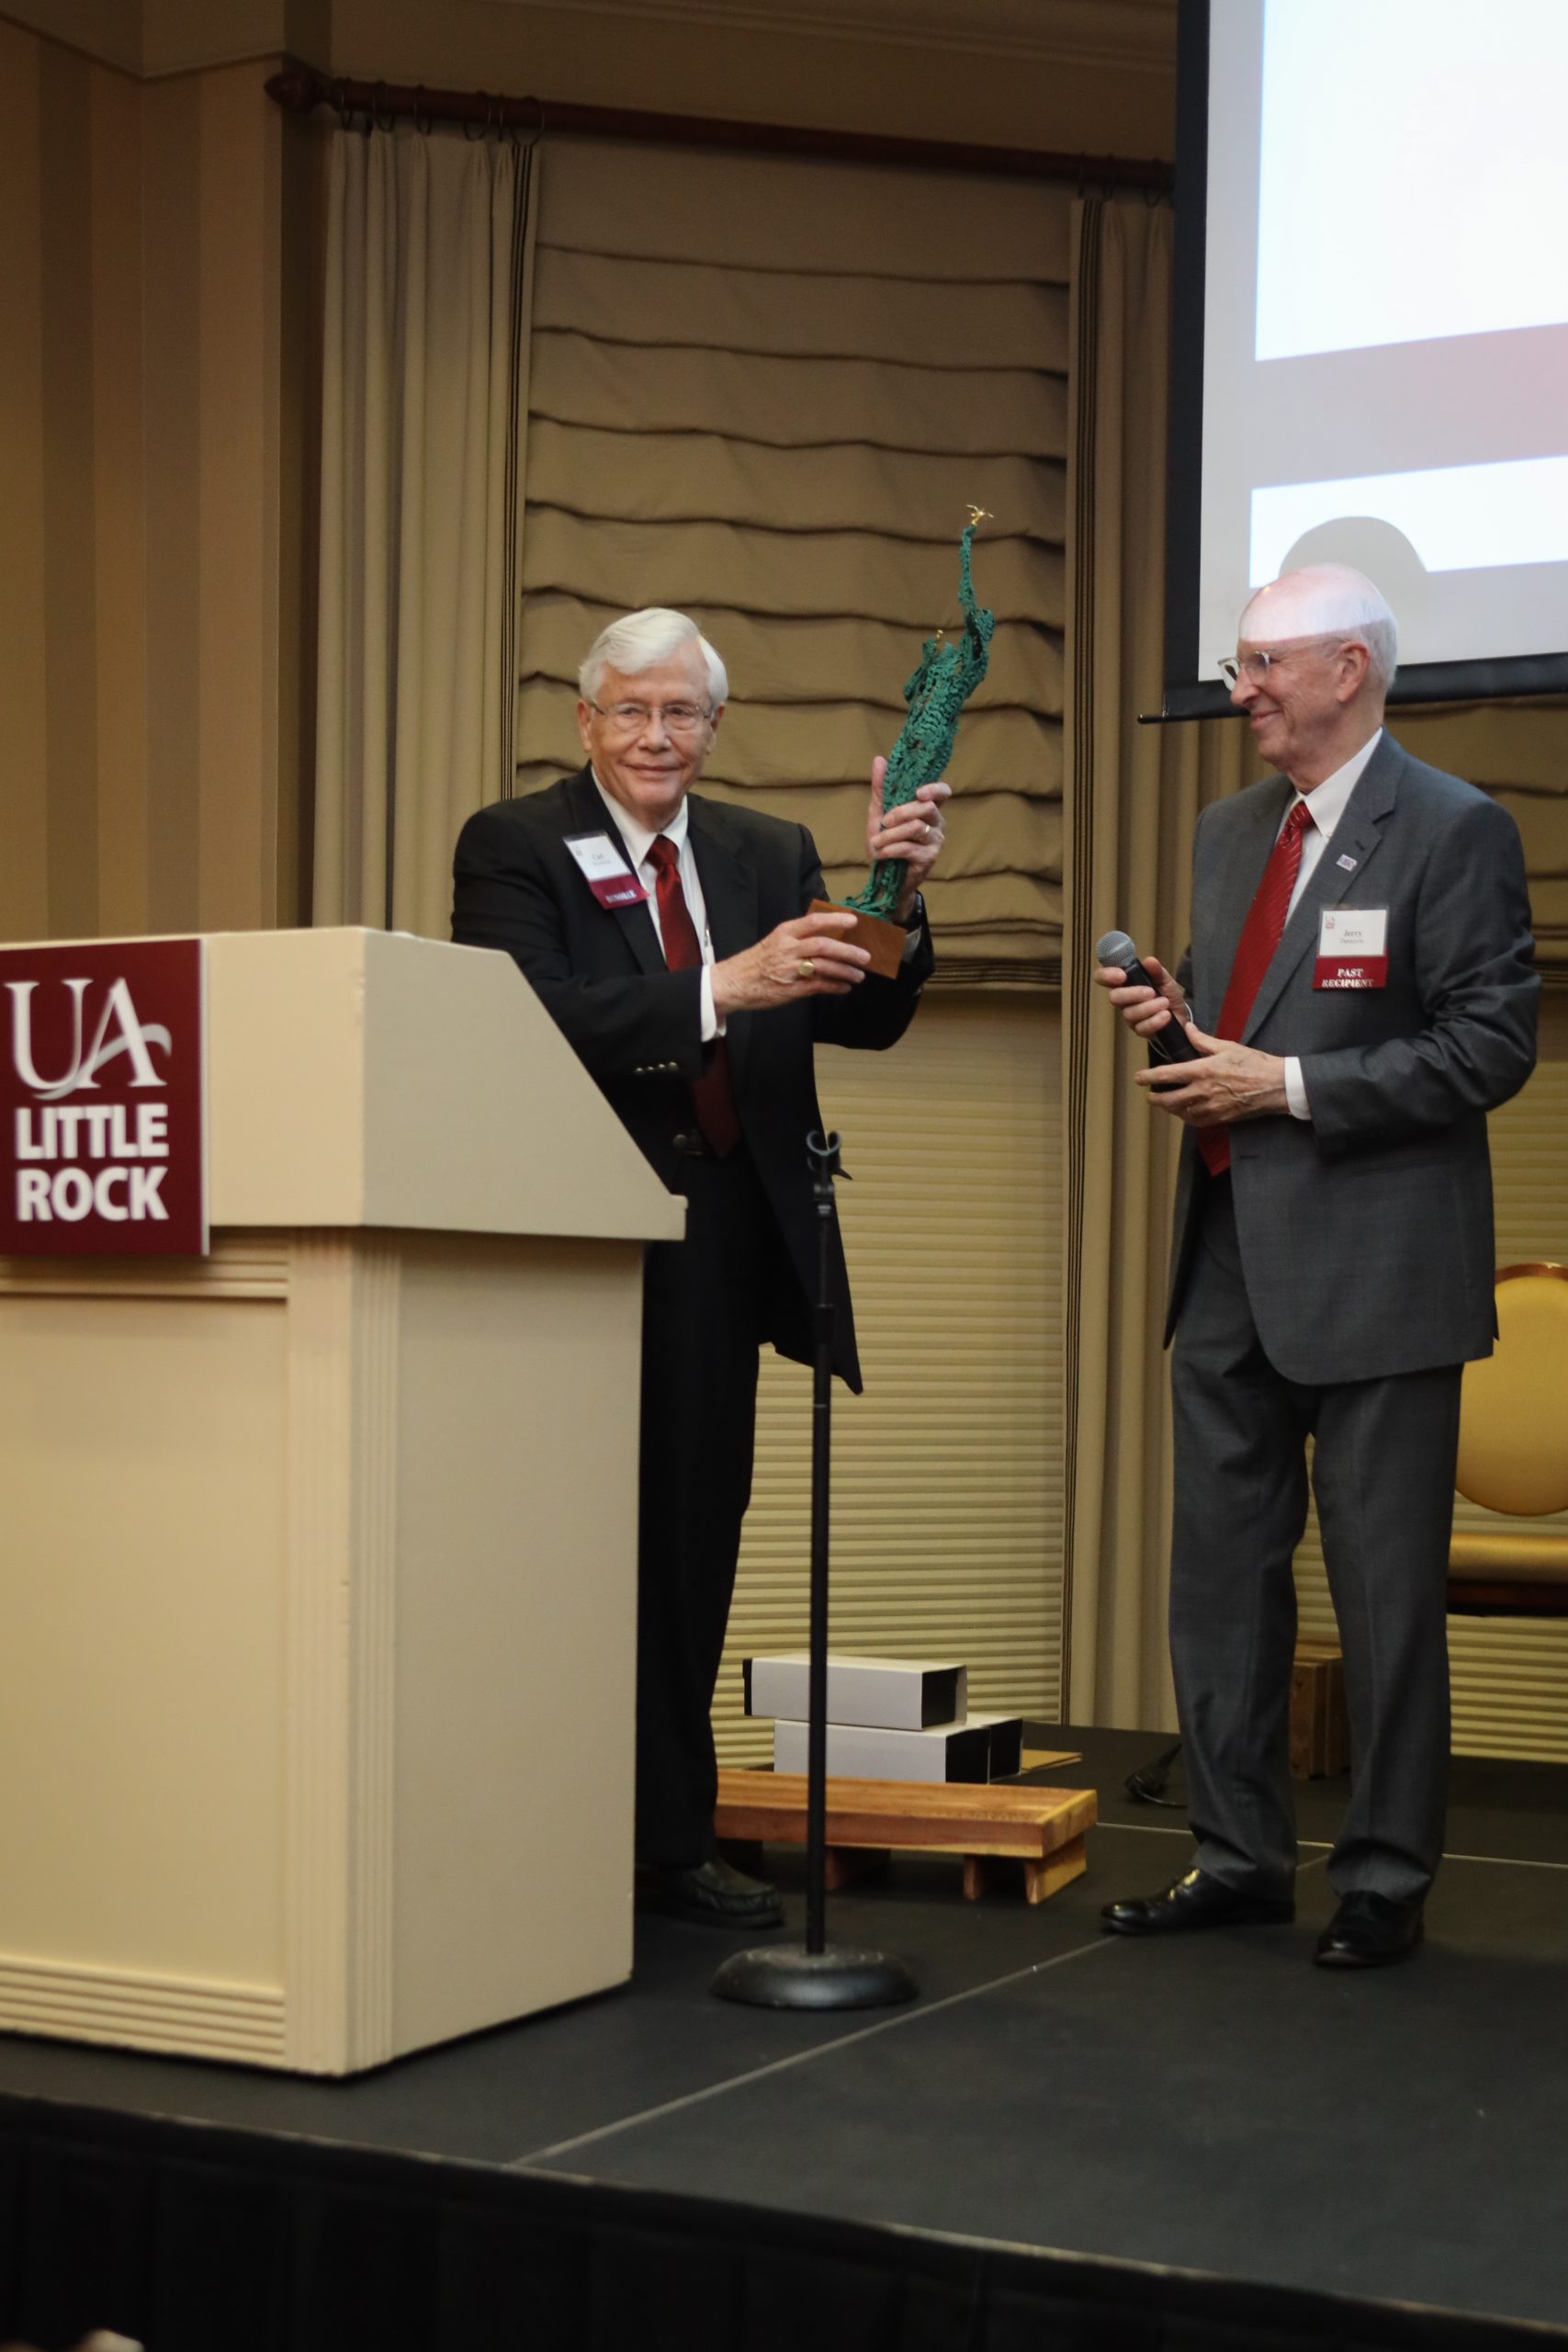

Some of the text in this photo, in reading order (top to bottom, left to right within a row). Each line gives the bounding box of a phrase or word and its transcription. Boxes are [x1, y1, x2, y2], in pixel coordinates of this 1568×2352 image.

[1321, 978, 1374, 989] RECIPIENT
[1337, 967, 1364, 978] PAST
[4, 977, 172, 1100] UA
[16, 1103, 169, 1159] LITTLE
[17, 1166, 169, 1222] ROCK
